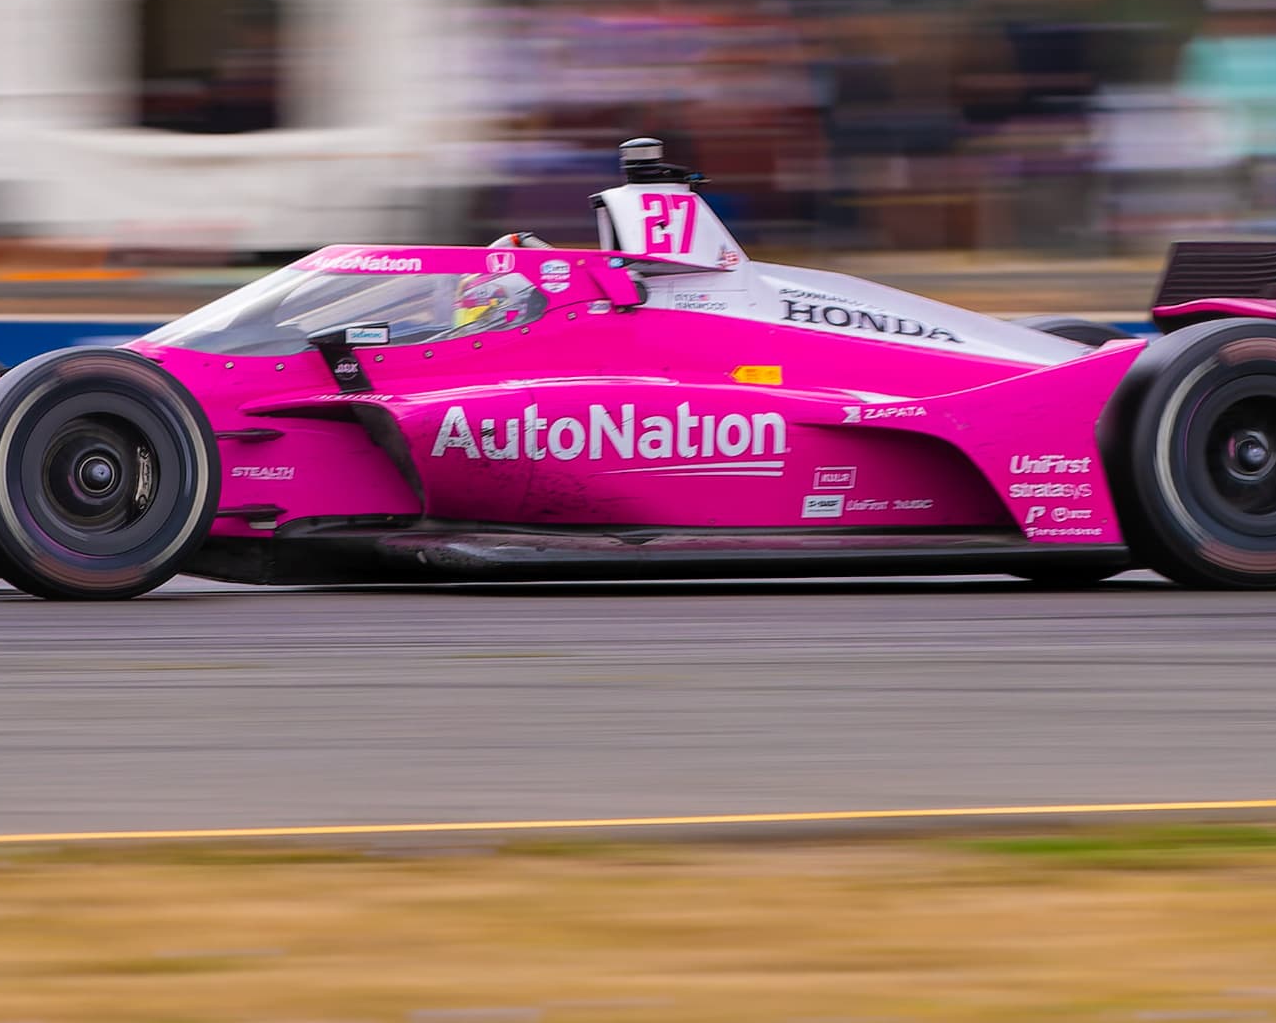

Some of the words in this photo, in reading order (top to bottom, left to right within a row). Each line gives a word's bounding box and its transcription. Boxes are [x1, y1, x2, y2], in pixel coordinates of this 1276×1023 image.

[641, 193, 697, 254] 27
[779, 299, 966, 344] HONDA
[863, 406, 927, 420] ZAPATA
[431, 401, 786, 461] AutoNation
[231, 466, 295, 478] STEALTH
[1009, 455, 1092, 474] UniFirst
